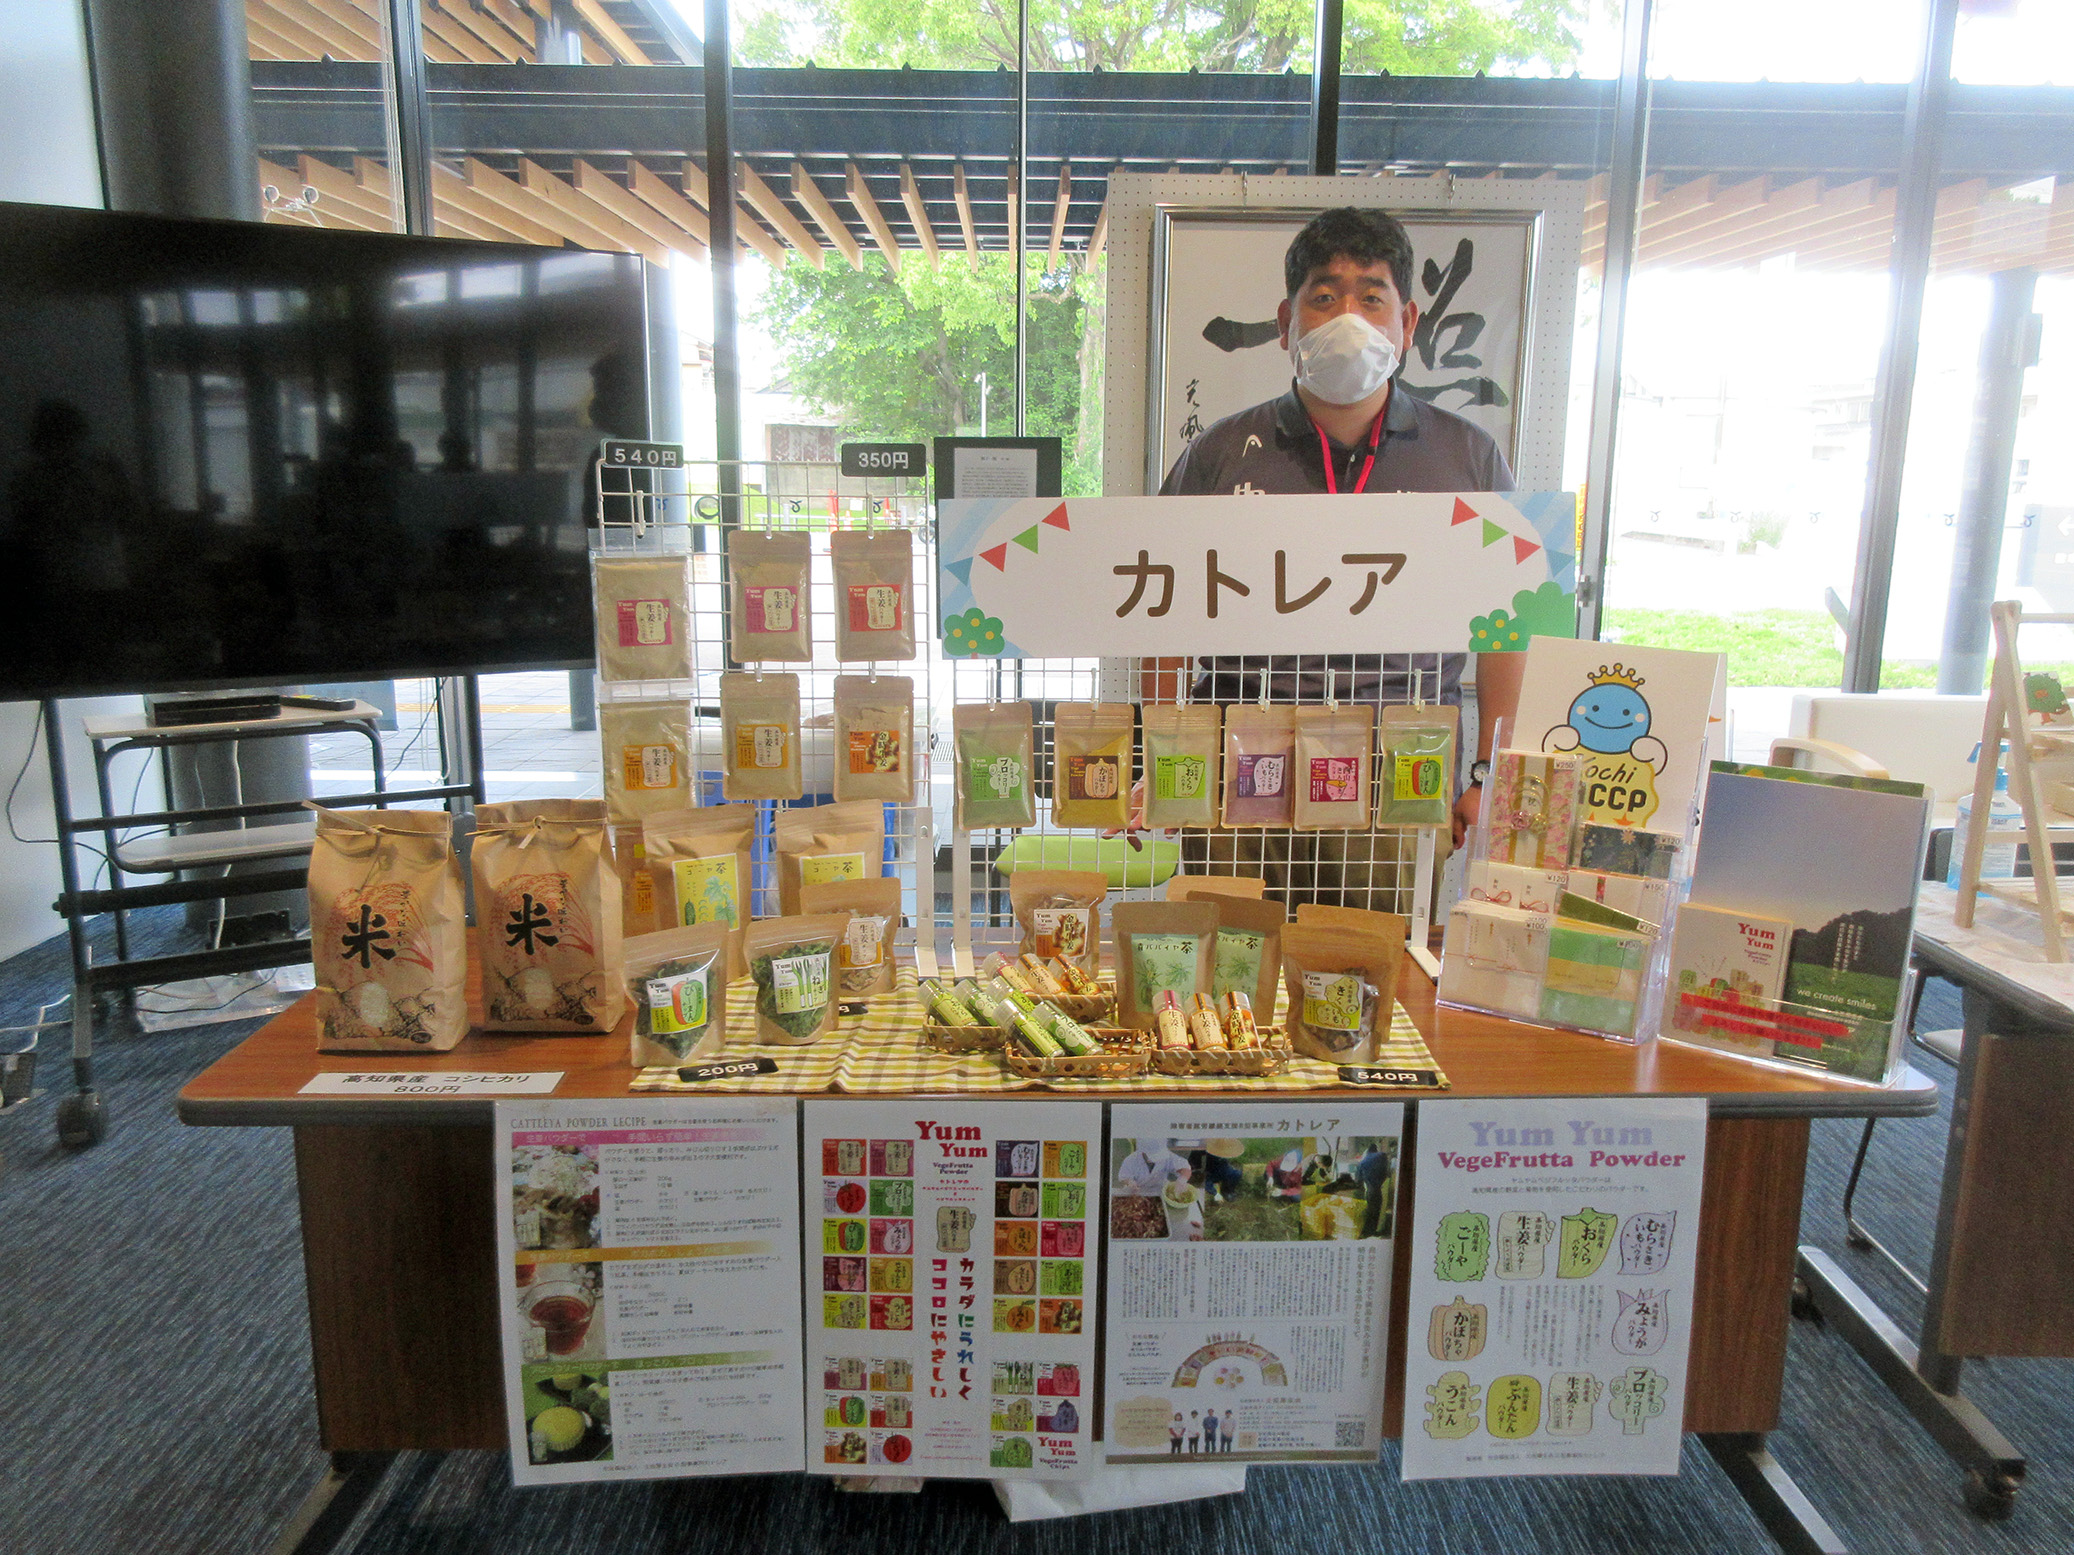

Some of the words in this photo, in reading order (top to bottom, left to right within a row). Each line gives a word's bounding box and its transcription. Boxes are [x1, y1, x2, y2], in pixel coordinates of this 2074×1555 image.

[615, 449, 677, 467] 540円
[858, 452, 909, 469] 350円
[1113, 549, 1407, 619] カトレア
[1660, 837, 1681, 846] ¥120
[1547, 875, 1567, 884] ¥120
[505, 893, 560, 956] 米
[1526, 922, 1545, 931] ¥100
[1638, 924, 1660, 935] ¥120
[1738, 922, 1775, 940] Yum
[341, 904, 397, 968] 米
[1747, 937, 1774, 950] Yum
[1797, 988, 1811, 997] we
[1813, 992, 1845, 1004] create
[1847, 997, 1877, 1011] smiles
[342, 1075, 430, 1084] 高知県産
[443, 1075, 532, 1084] コシヒカリ
[698, 1063, 759, 1077] 200円
[1357, 1071, 1419, 1082] 540円
[394, 1085, 462, 1093] 800円
[566, 1118, 608, 1128] POWDER
[613, 1116, 647, 1127] LECIPE
[915, 1120, 981, 1140] Yum
[1277, 1118, 1341, 1132] カトレア
[1468, 1121, 1554, 1147] Yum
[1567, 1120, 1653, 1146] Yum
[939, 1143, 988, 1158] Yum
[1438, 1151, 1574, 1173] VegeFrutta
[1589, 1150, 1686, 1168] Powder
[1456, 1226, 1471, 1267] ごーや
[1517, 1215, 1530, 1271] 生姜パウダー
[1581, 1226, 1596, 1265] おくら
[1644, 1219, 1660, 1266] むらさき
[930, 1259, 947, 1398] ココロにやさしい
[957, 1258, 976, 1400] カラダにうれしく
[1453, 1312, 1468, 1356] かぼちゃ
[1635, 1302, 1651, 1349] みょうが
[1445, 1385, 1459, 1426] うこん
[1567, 1376, 1580, 1428] 生姜パウダー
[1633, 1369, 1649, 1426] ブロッコリー
[1037, 1436, 1073, 1448] Yum
[1050, 1447, 1076, 1456] Yum
